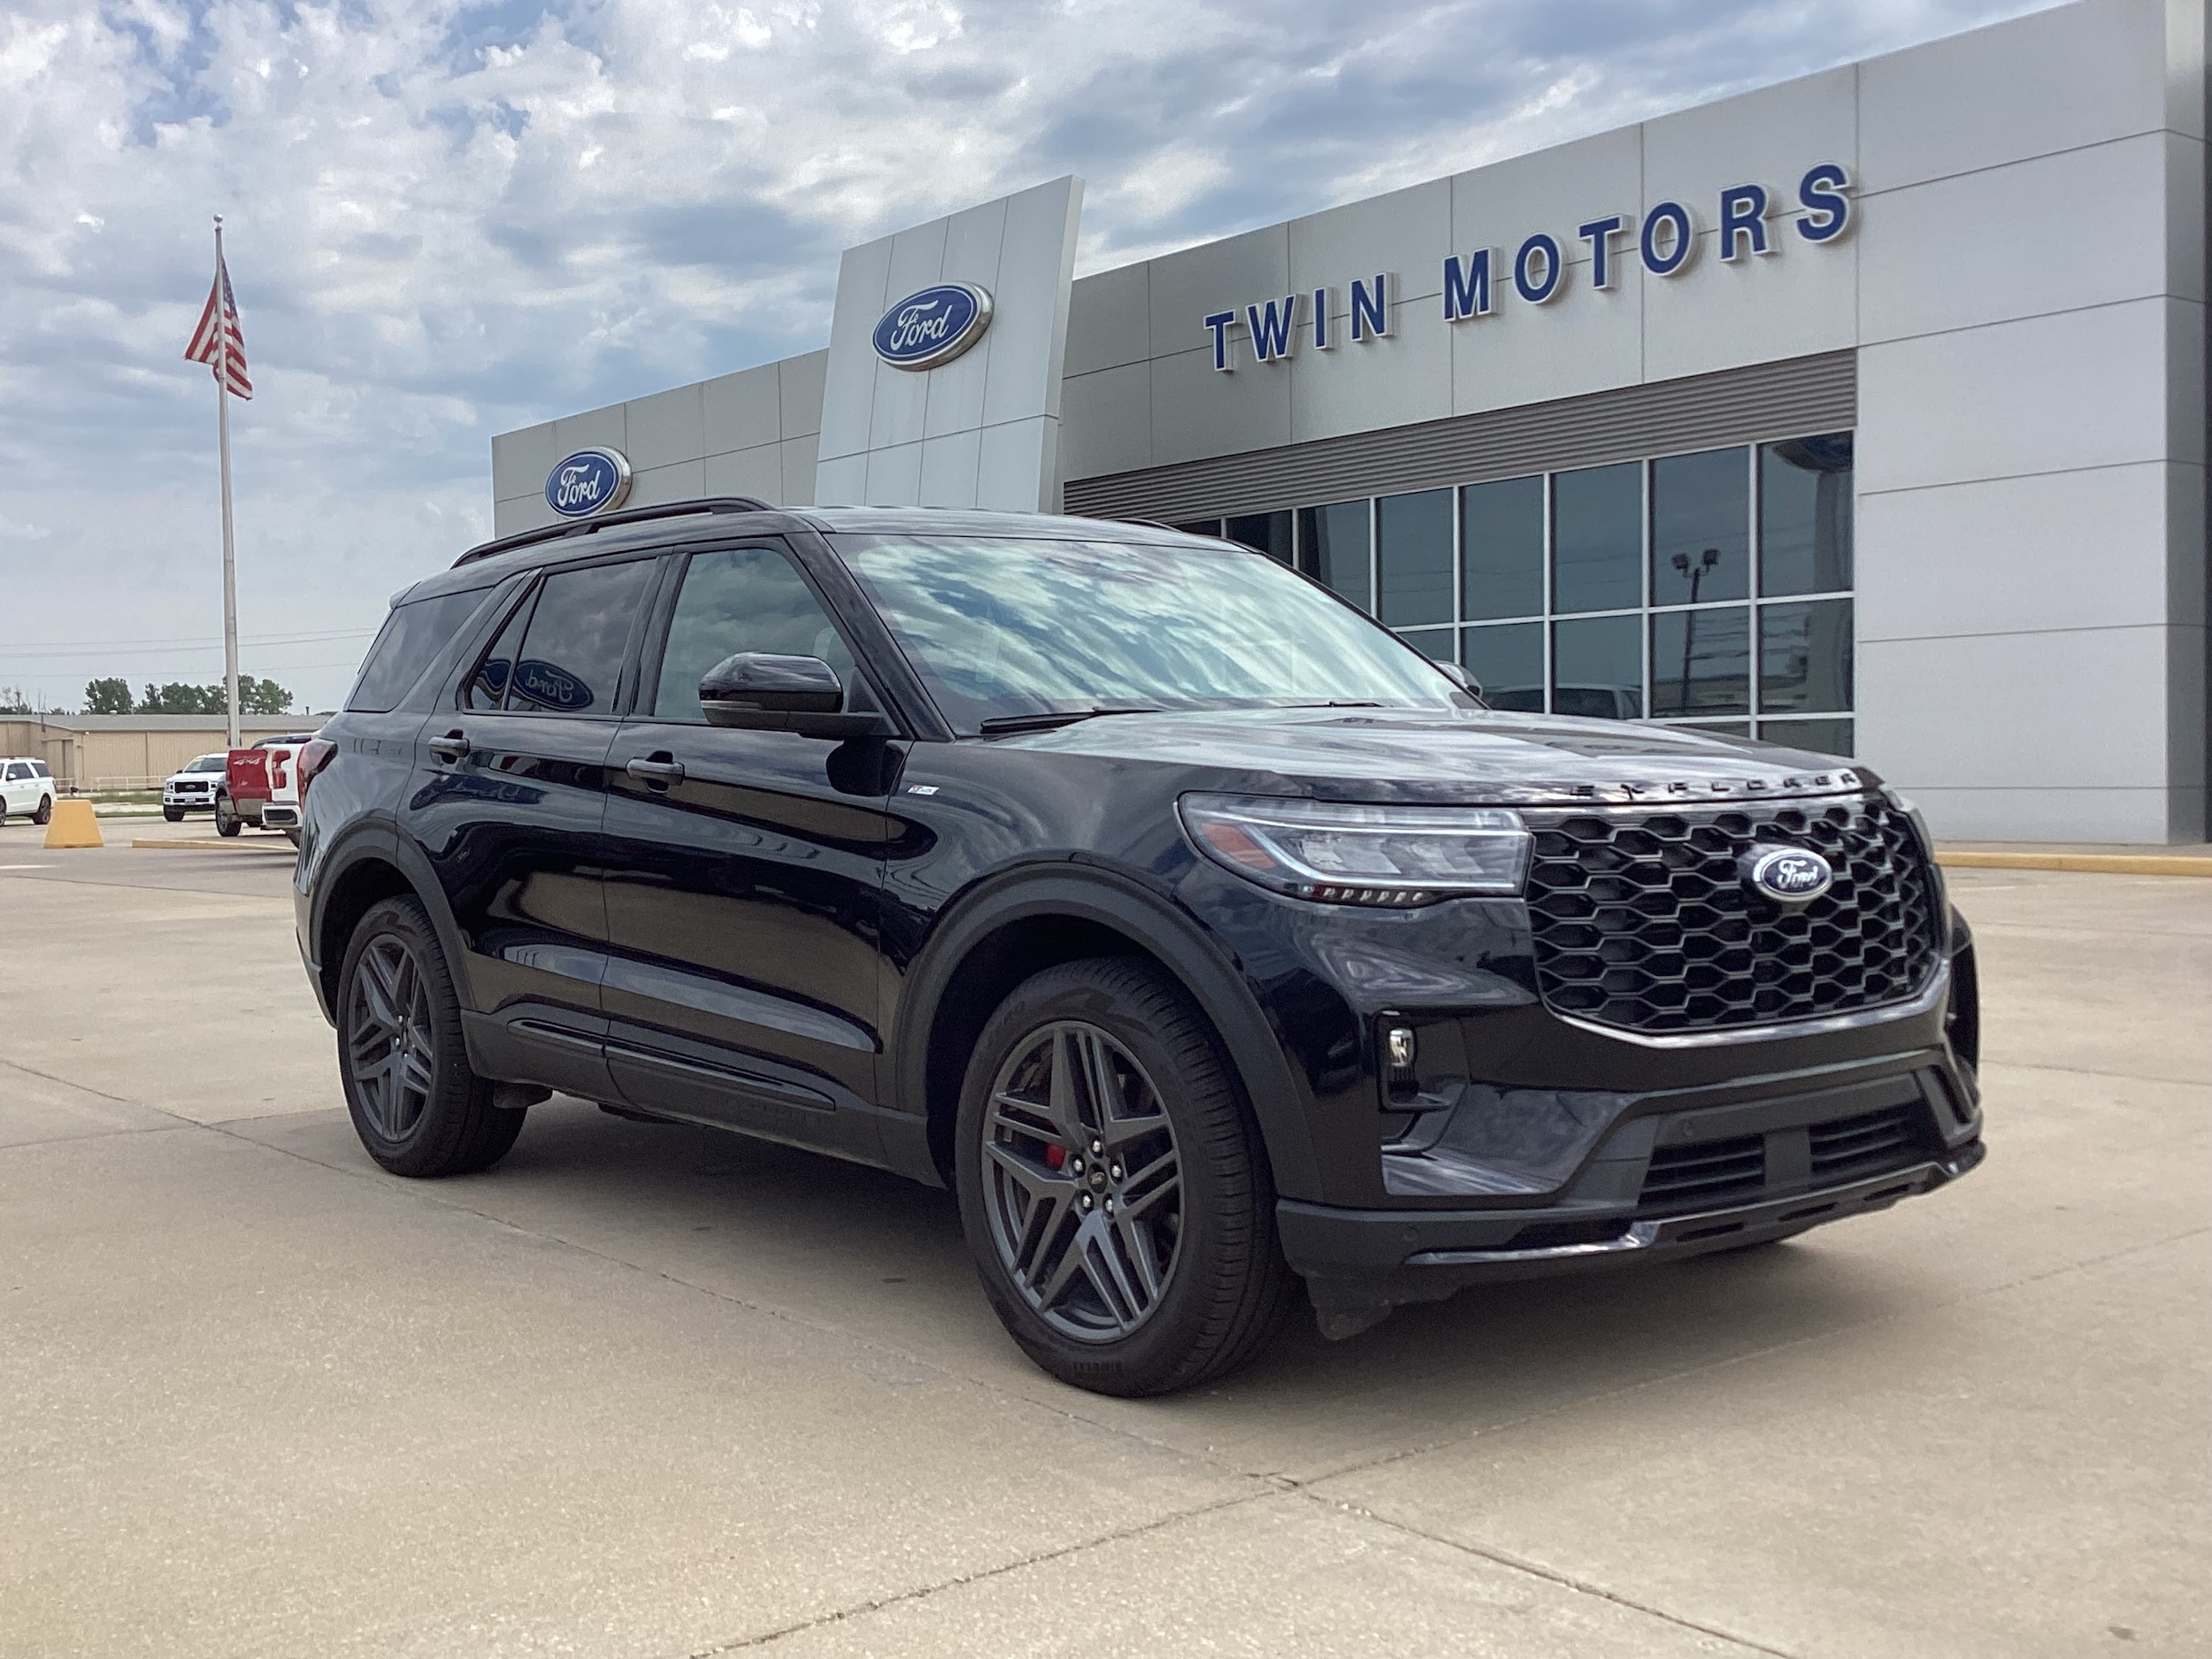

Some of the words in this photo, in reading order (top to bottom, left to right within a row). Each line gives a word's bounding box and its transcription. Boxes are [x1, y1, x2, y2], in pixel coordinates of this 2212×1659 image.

[1204, 273, 1393, 373] TWIN
[1443, 163, 1852, 321] MOTORS
[889, 299, 953, 351] Ford
[557, 464, 602, 507] Ford
[1571, 772, 1857, 800] EXPLORER
[1777, 859, 1819, 889] Ford
